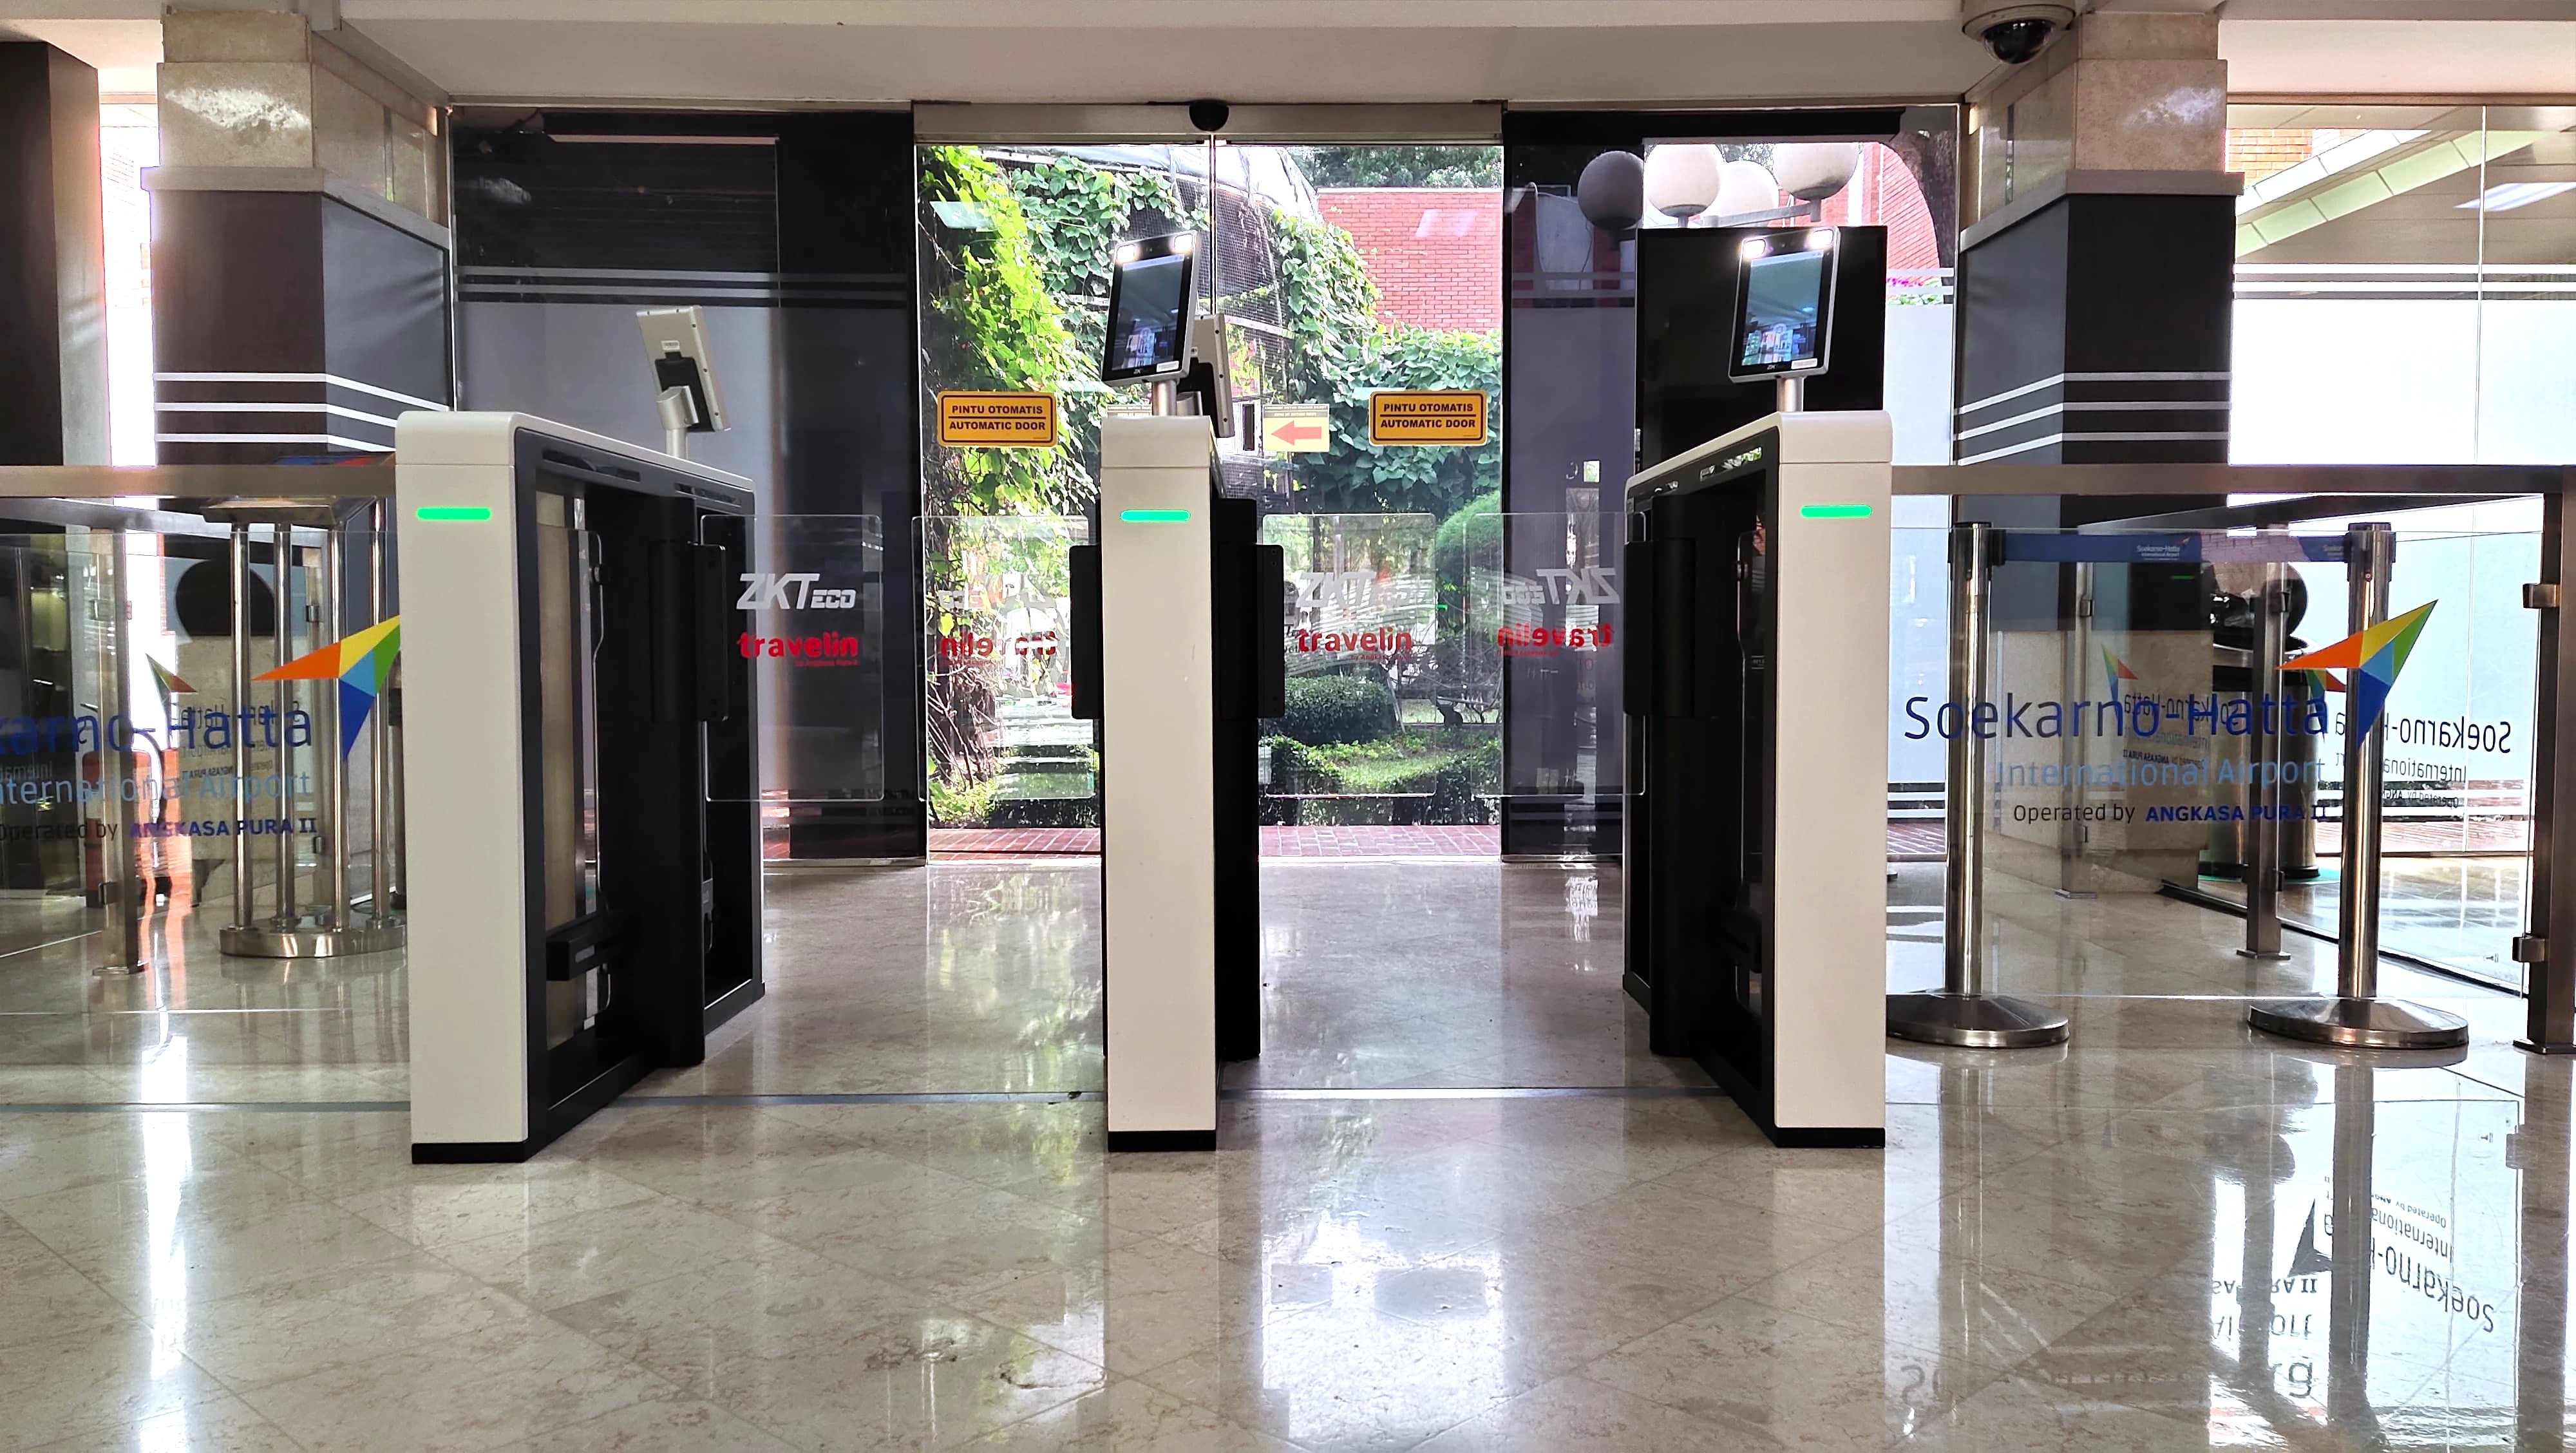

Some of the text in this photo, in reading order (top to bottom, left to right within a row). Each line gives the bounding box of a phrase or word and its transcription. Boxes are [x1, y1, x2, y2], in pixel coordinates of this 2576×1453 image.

[952, 405, 1043, 414] PINTU OTOMATIS
[1383, 403, 1473, 412] PINTU OTOMATIS
[949, 421, 1045, 430] AUTOMATIC DOOR
[1380, 419, 1475, 428] AUTOMATIC DOOR
[736, 630, 858, 659] travelin
[1295, 626, 1412, 652] travelin
[0, 702, 312, 754] arno-Hatta
[1904, 692, 2329, 740] Soekarno-Hatta
[1999, 757, 2208, 787] International
[2218, 757, 2326, 788] Airport
[200, 773, 312, 804] Airport
[2014, 803, 2327, 824] Operated by ANGKASA PURA II
[97, 822, 118, 841] by
[130, 822, 231, 838] ANGKASA
[238, 820, 294, 836] PURA
[299, 818, 318, 834] II
